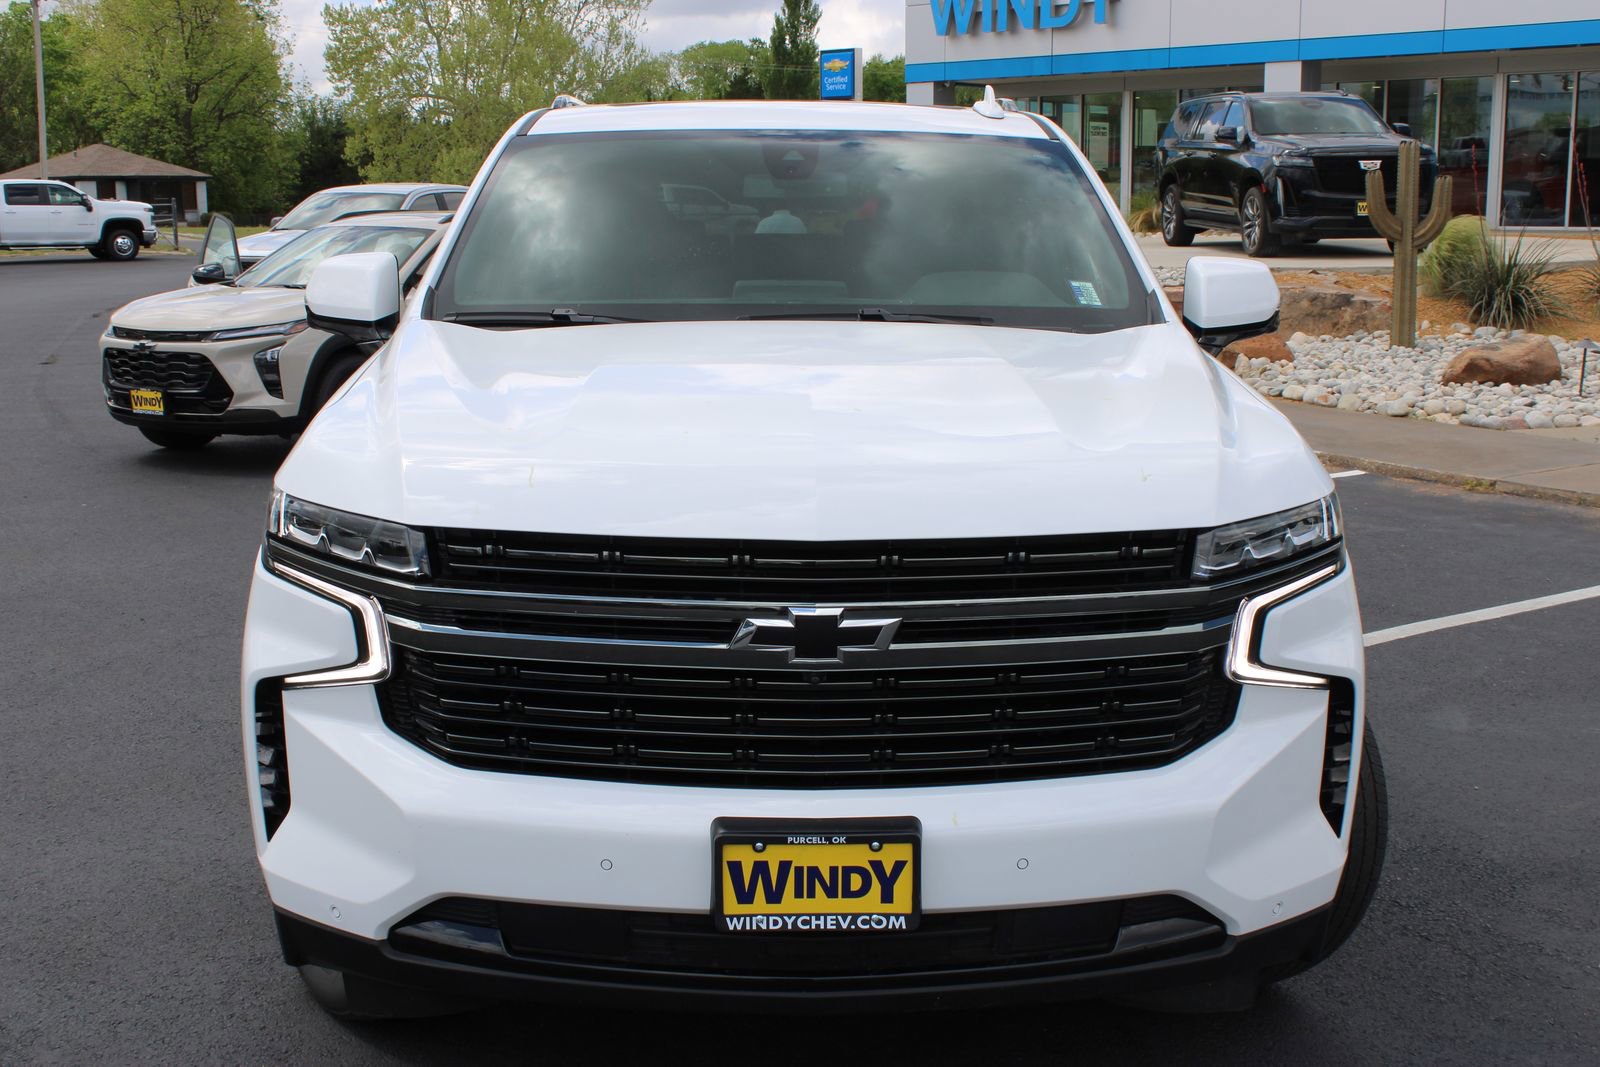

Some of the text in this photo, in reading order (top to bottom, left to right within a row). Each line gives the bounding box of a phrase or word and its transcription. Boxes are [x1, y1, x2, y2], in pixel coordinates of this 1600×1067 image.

[824, 75, 848, 84] Certified
[132, 395, 162, 409] WINDY
[787, 836, 846, 844] PURCELL, OK
[726, 860, 908, 904] WINDY
[726, 915, 907, 930] WINDYCHEV.COM
